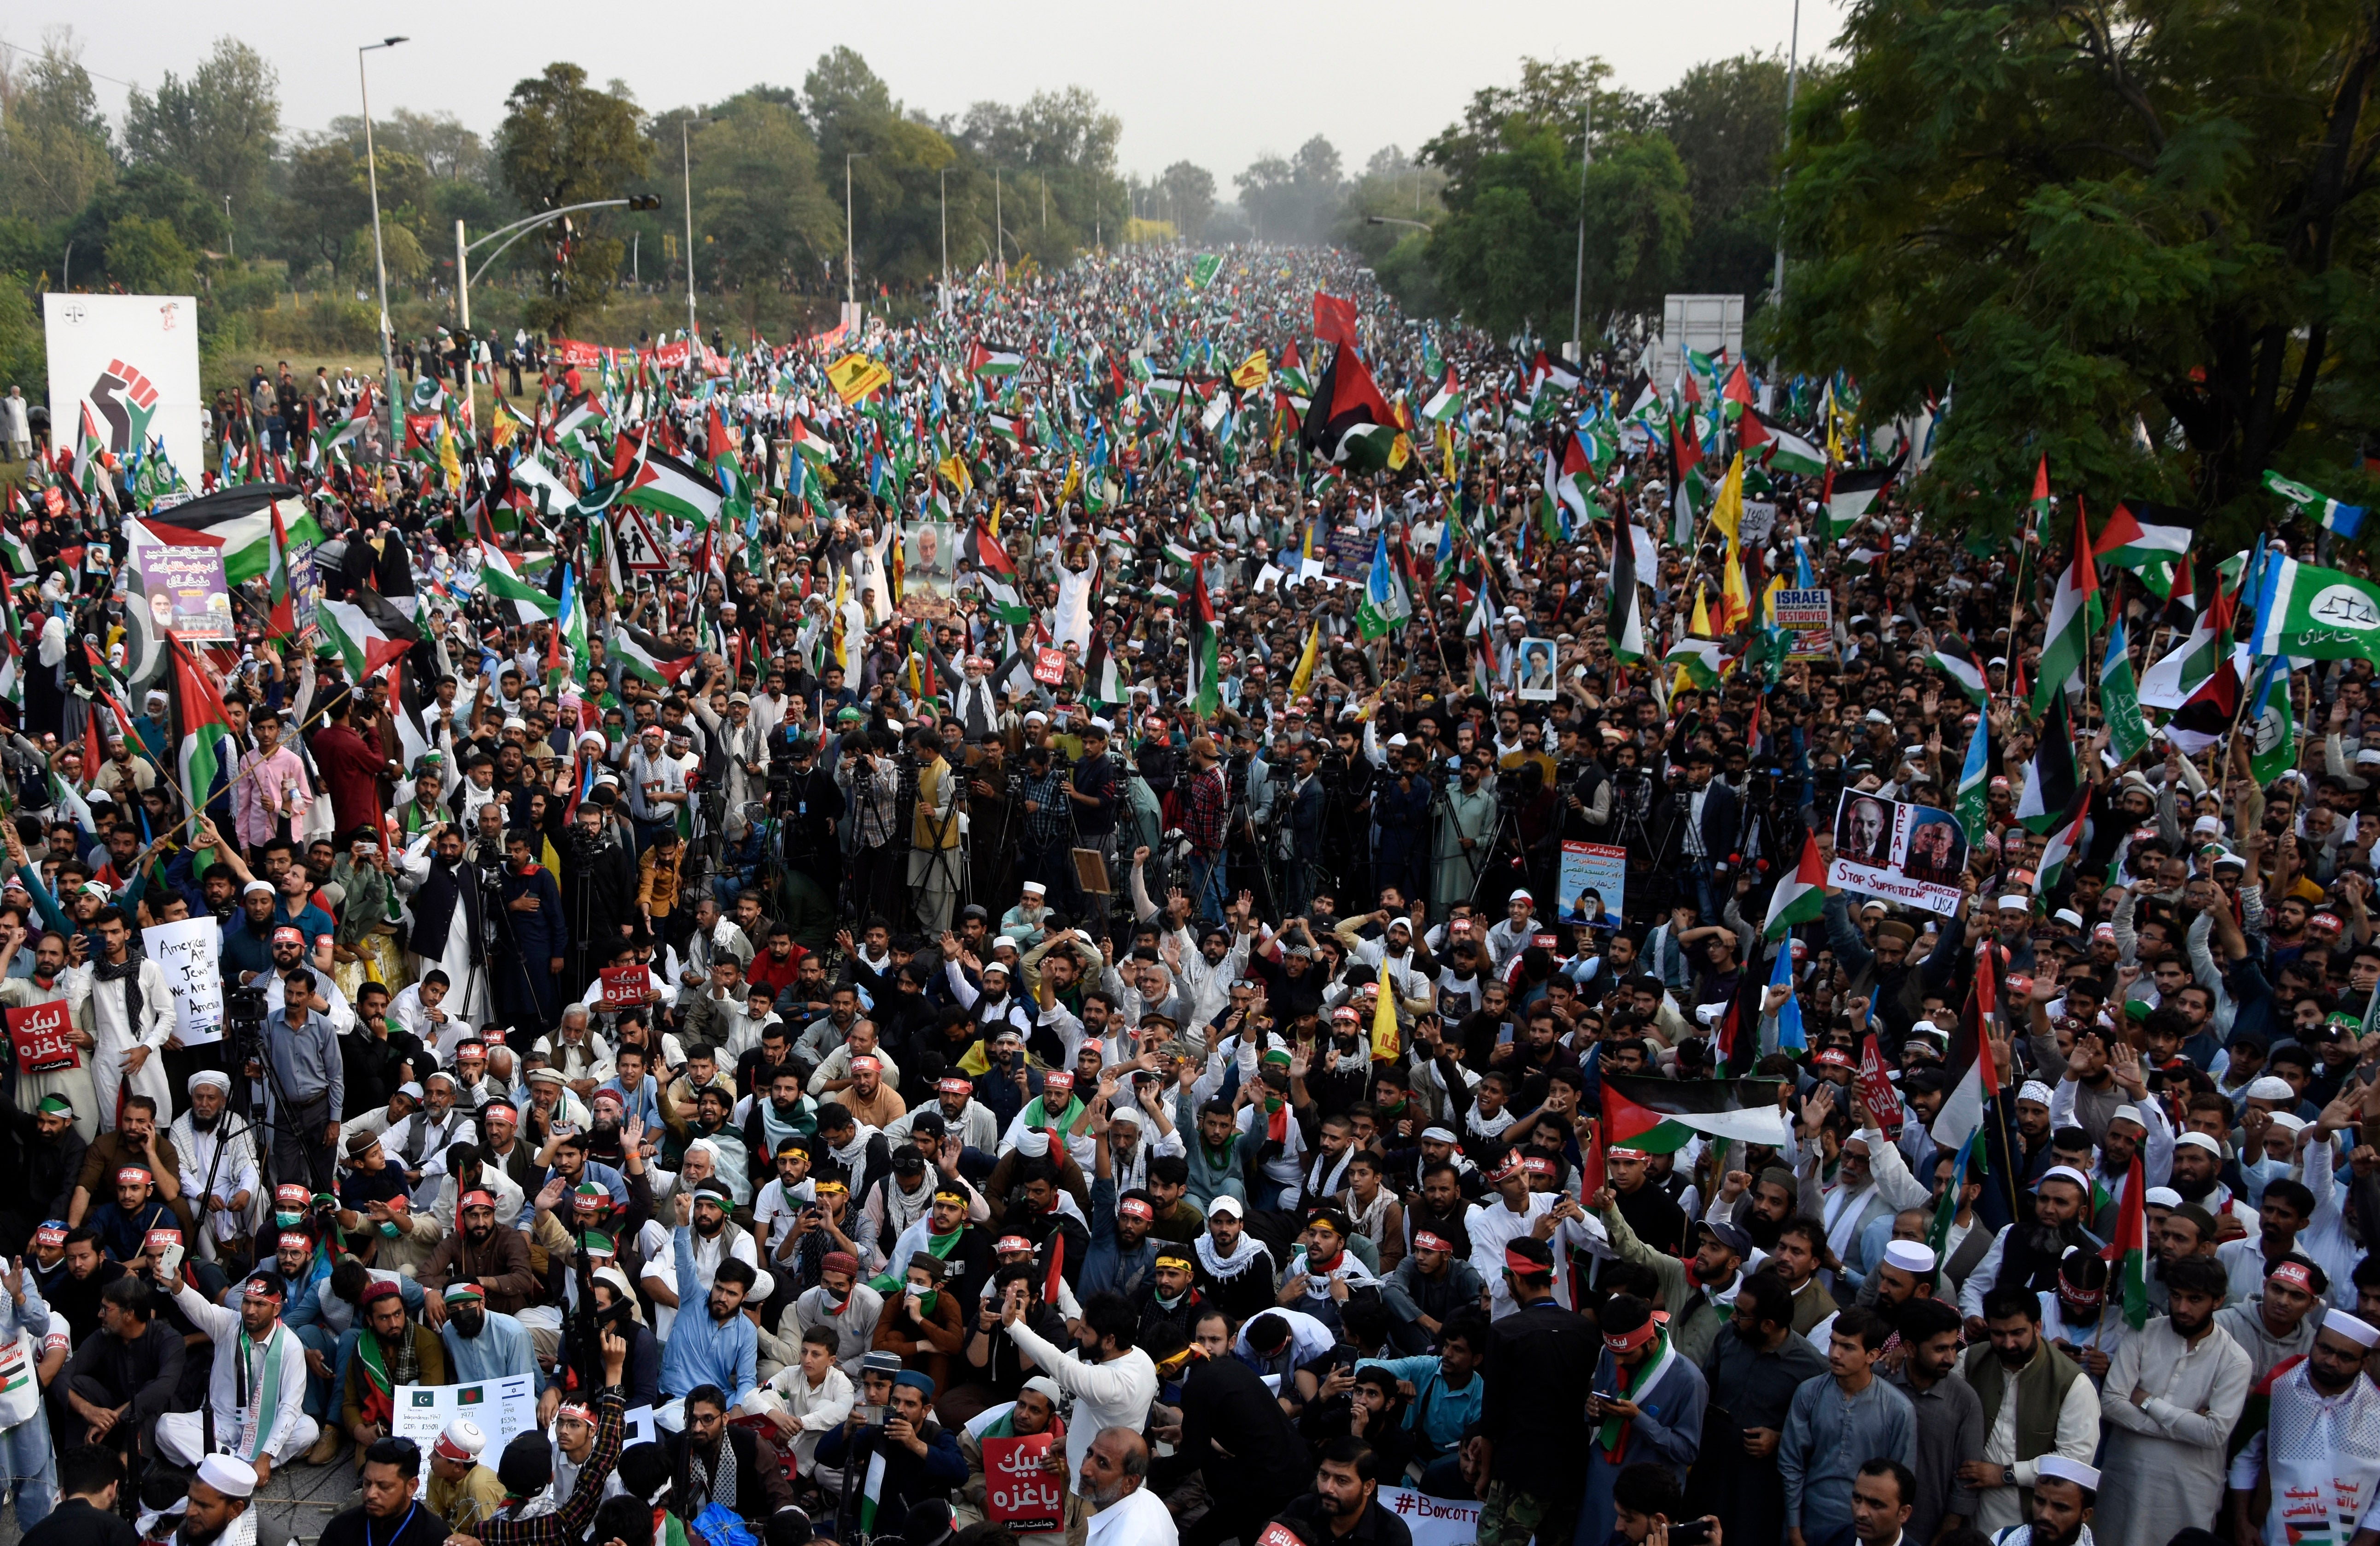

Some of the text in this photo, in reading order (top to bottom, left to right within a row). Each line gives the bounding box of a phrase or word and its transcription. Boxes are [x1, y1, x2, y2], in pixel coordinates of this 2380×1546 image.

[1776, 591, 1827, 604] ISRAEL
[1777, 611, 1827, 621] DESTROYED
[1042, 653, 1062, 667] لبیک
[1579, 857, 1607, 866] فلسطین
[1932, 896, 1953, 915] USA
[181, 965, 208, 981] Jews
[610, 971, 642, 984] لبیک
[169, 985, 187, 998] We
[191, 983, 206, 994] Are
[19, 1010, 60, 1035] لبیک
[2285, 1486, 2319, 1498] لبیک
[1027, 1519, 1054, 1528] جماعت
